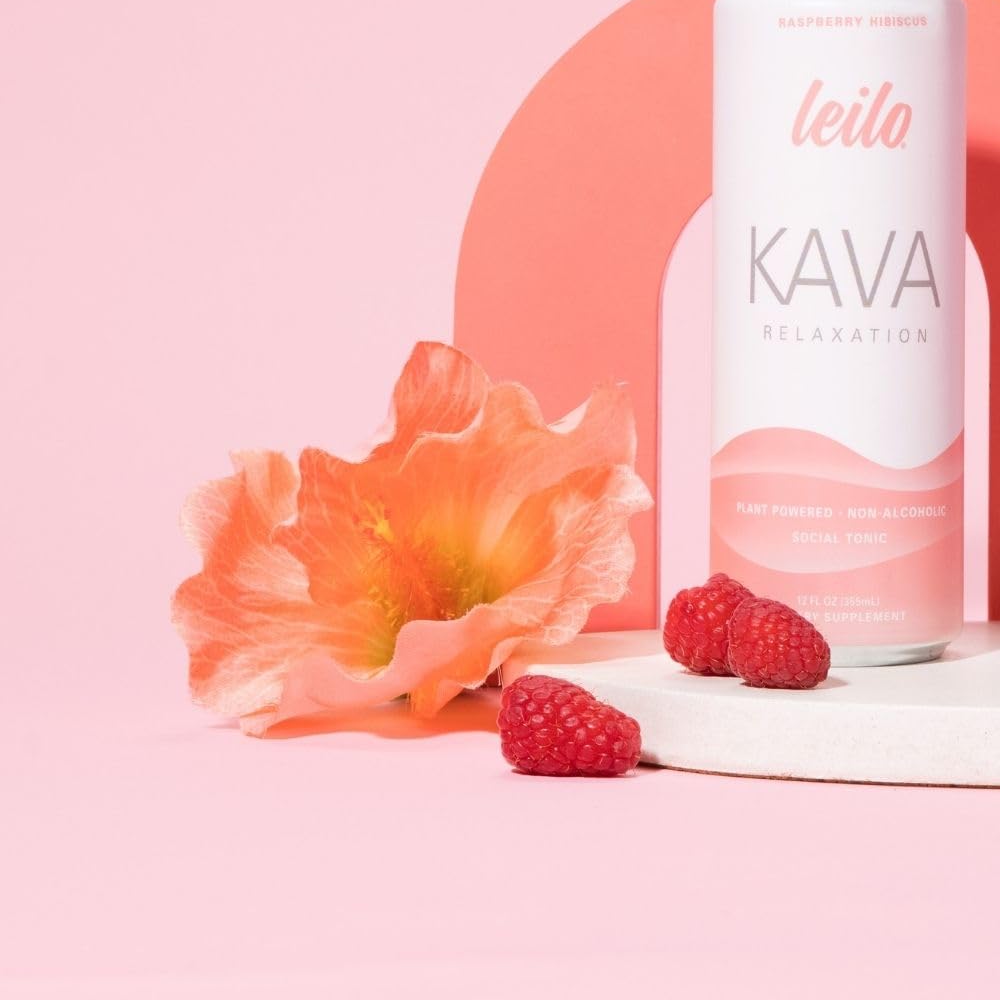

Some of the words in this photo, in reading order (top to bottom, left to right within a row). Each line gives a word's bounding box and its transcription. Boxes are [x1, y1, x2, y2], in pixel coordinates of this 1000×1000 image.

[778, 16, 862, 28] RASPBERRY
[869, 15, 928, 27] HIBISCUS
[791, 78, 913, 149] leilo
[748, 225, 941, 308] KAVA
[763, 324, 928, 344] RELAXATION
[736, 501, 767, 516] PLANT
[772, 504, 833, 519] POWERED
[847, 504, 947, 519] NON-ALCOHOLIC
[791, 531, 840, 545] SOCIAL
[845, 532, 888, 545] TONIC
[797, 596, 807, 606] 12
[809, 596, 820, 606] FL
[823, 596, 838, 606] OZ
[823, 611, 906, 623] SUPPLEMENT
